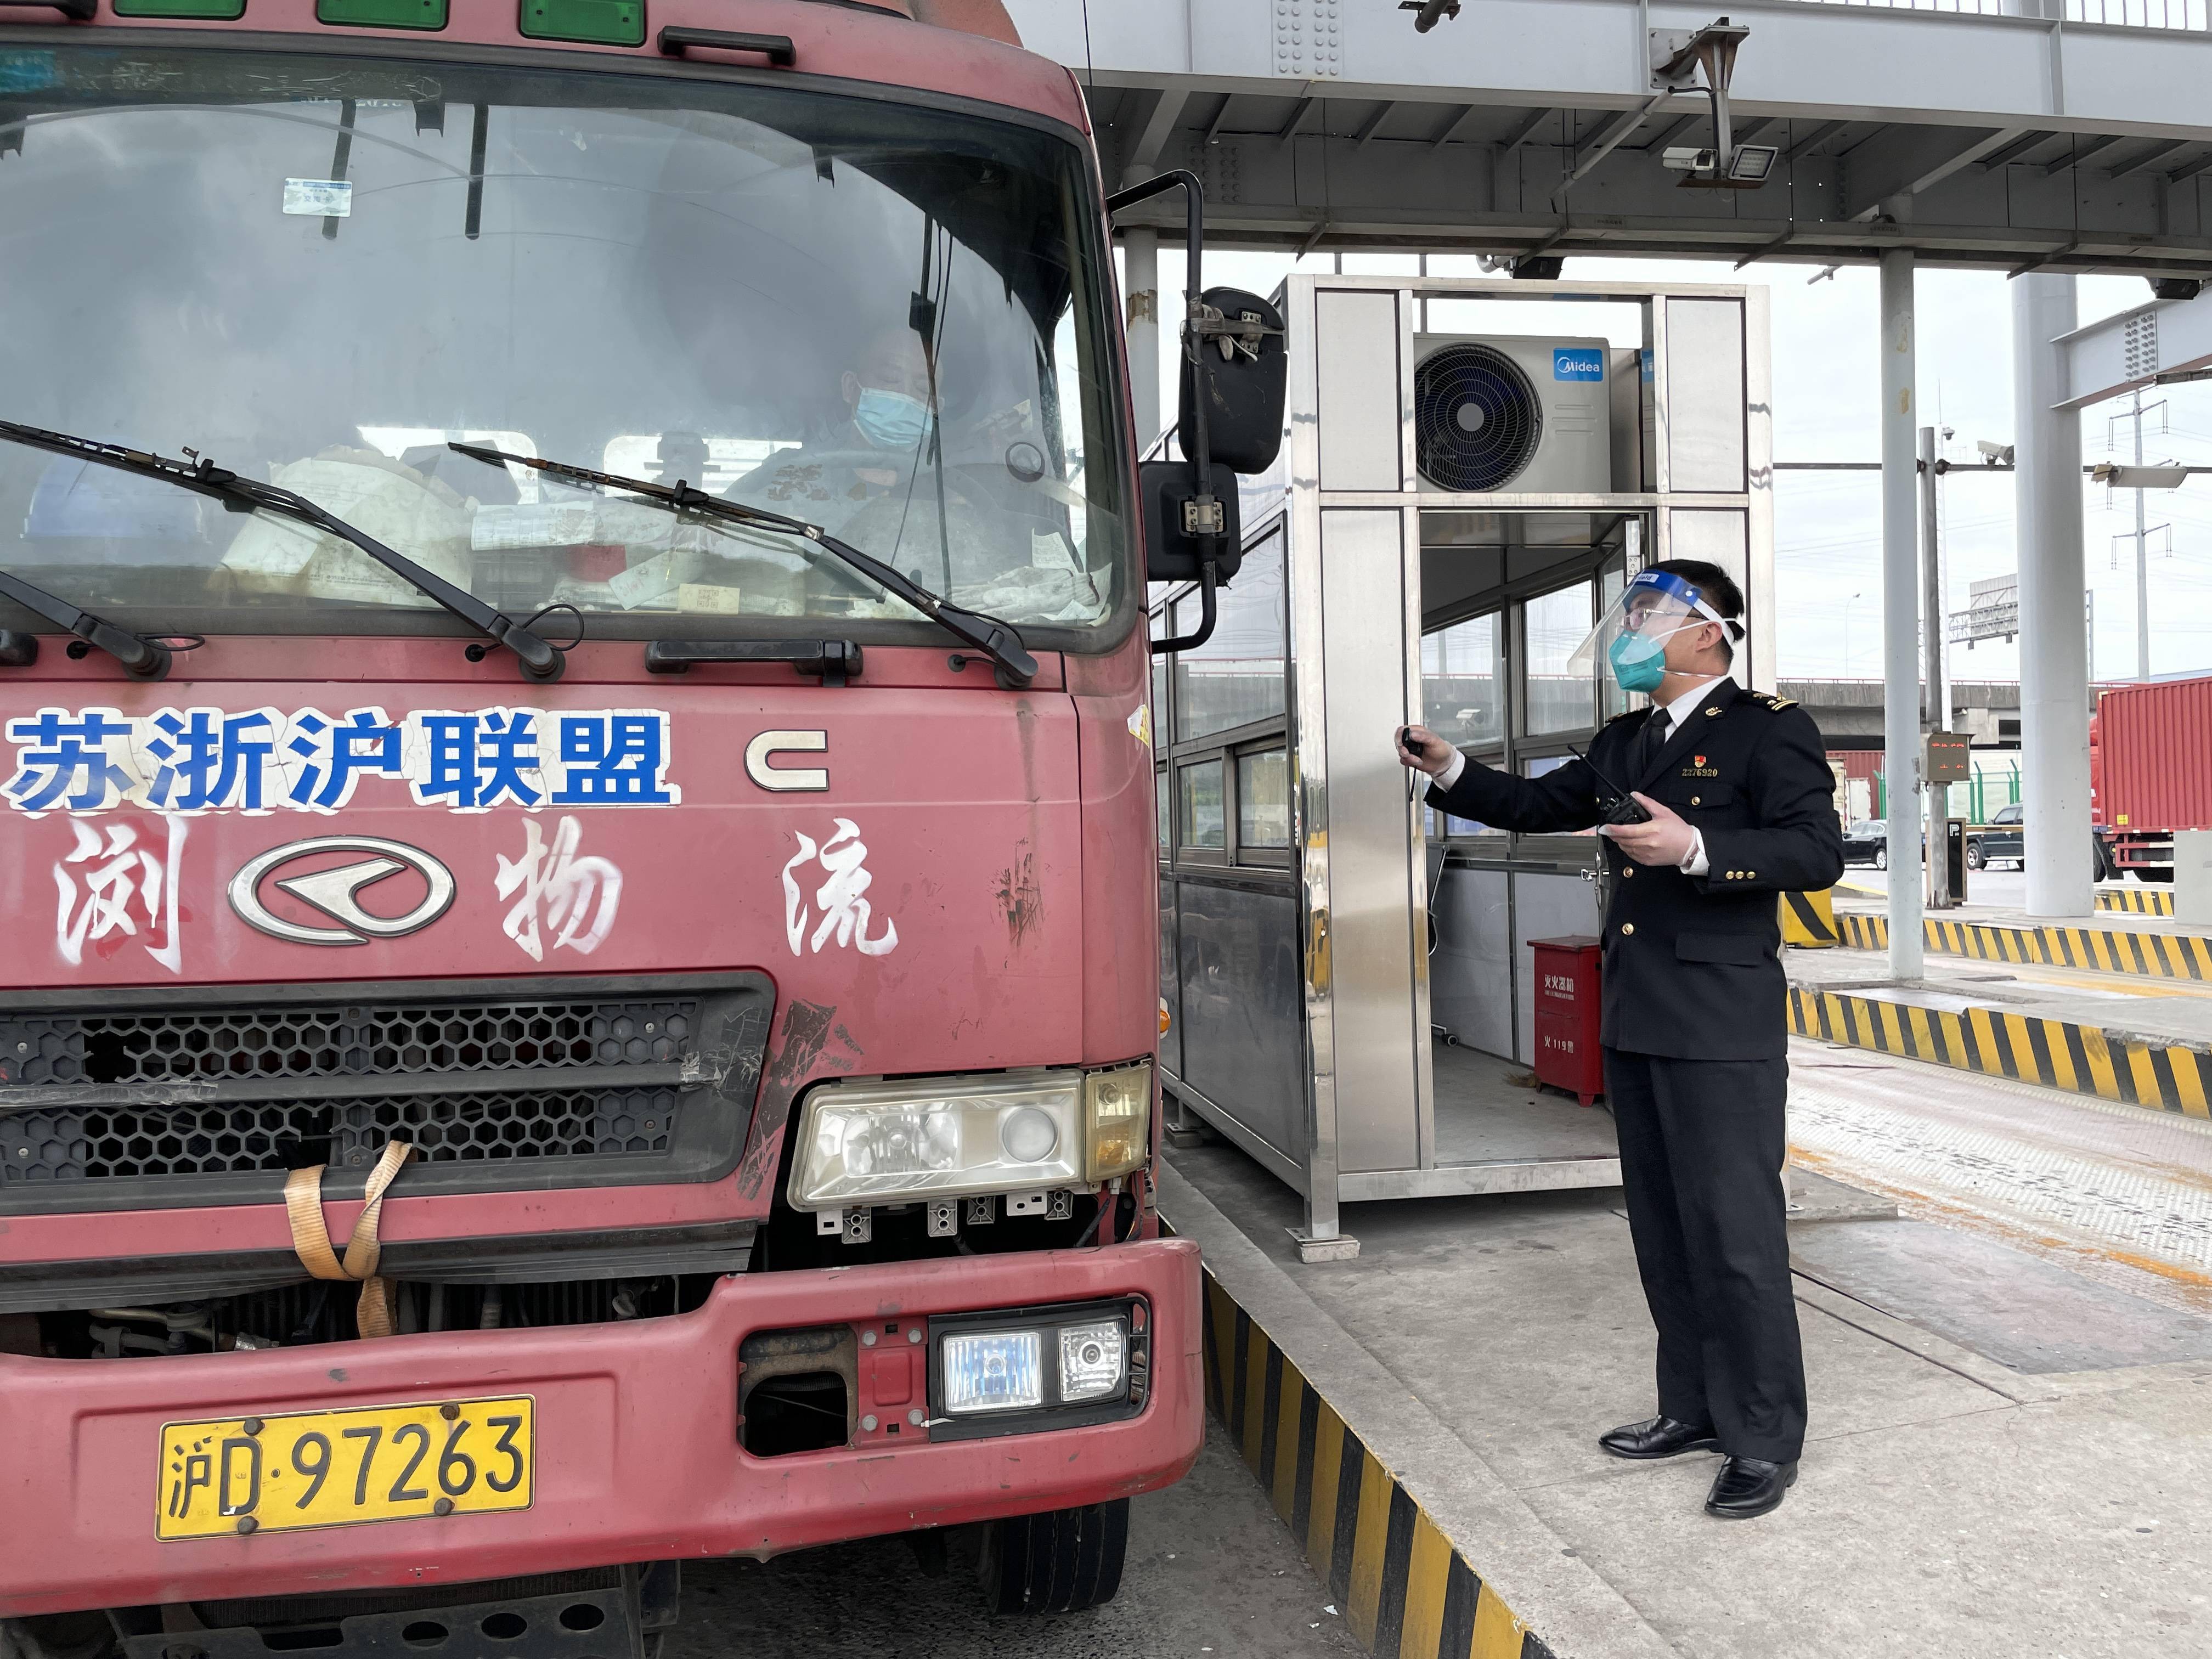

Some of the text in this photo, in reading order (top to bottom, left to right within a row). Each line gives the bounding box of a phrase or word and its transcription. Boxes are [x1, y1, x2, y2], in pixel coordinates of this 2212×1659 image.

[1558, 357, 1600, 373] Midea
[8, 712, 671, 810] 苏浙沪联盟
[1544, 974, 1574, 992] 灭火器箱
